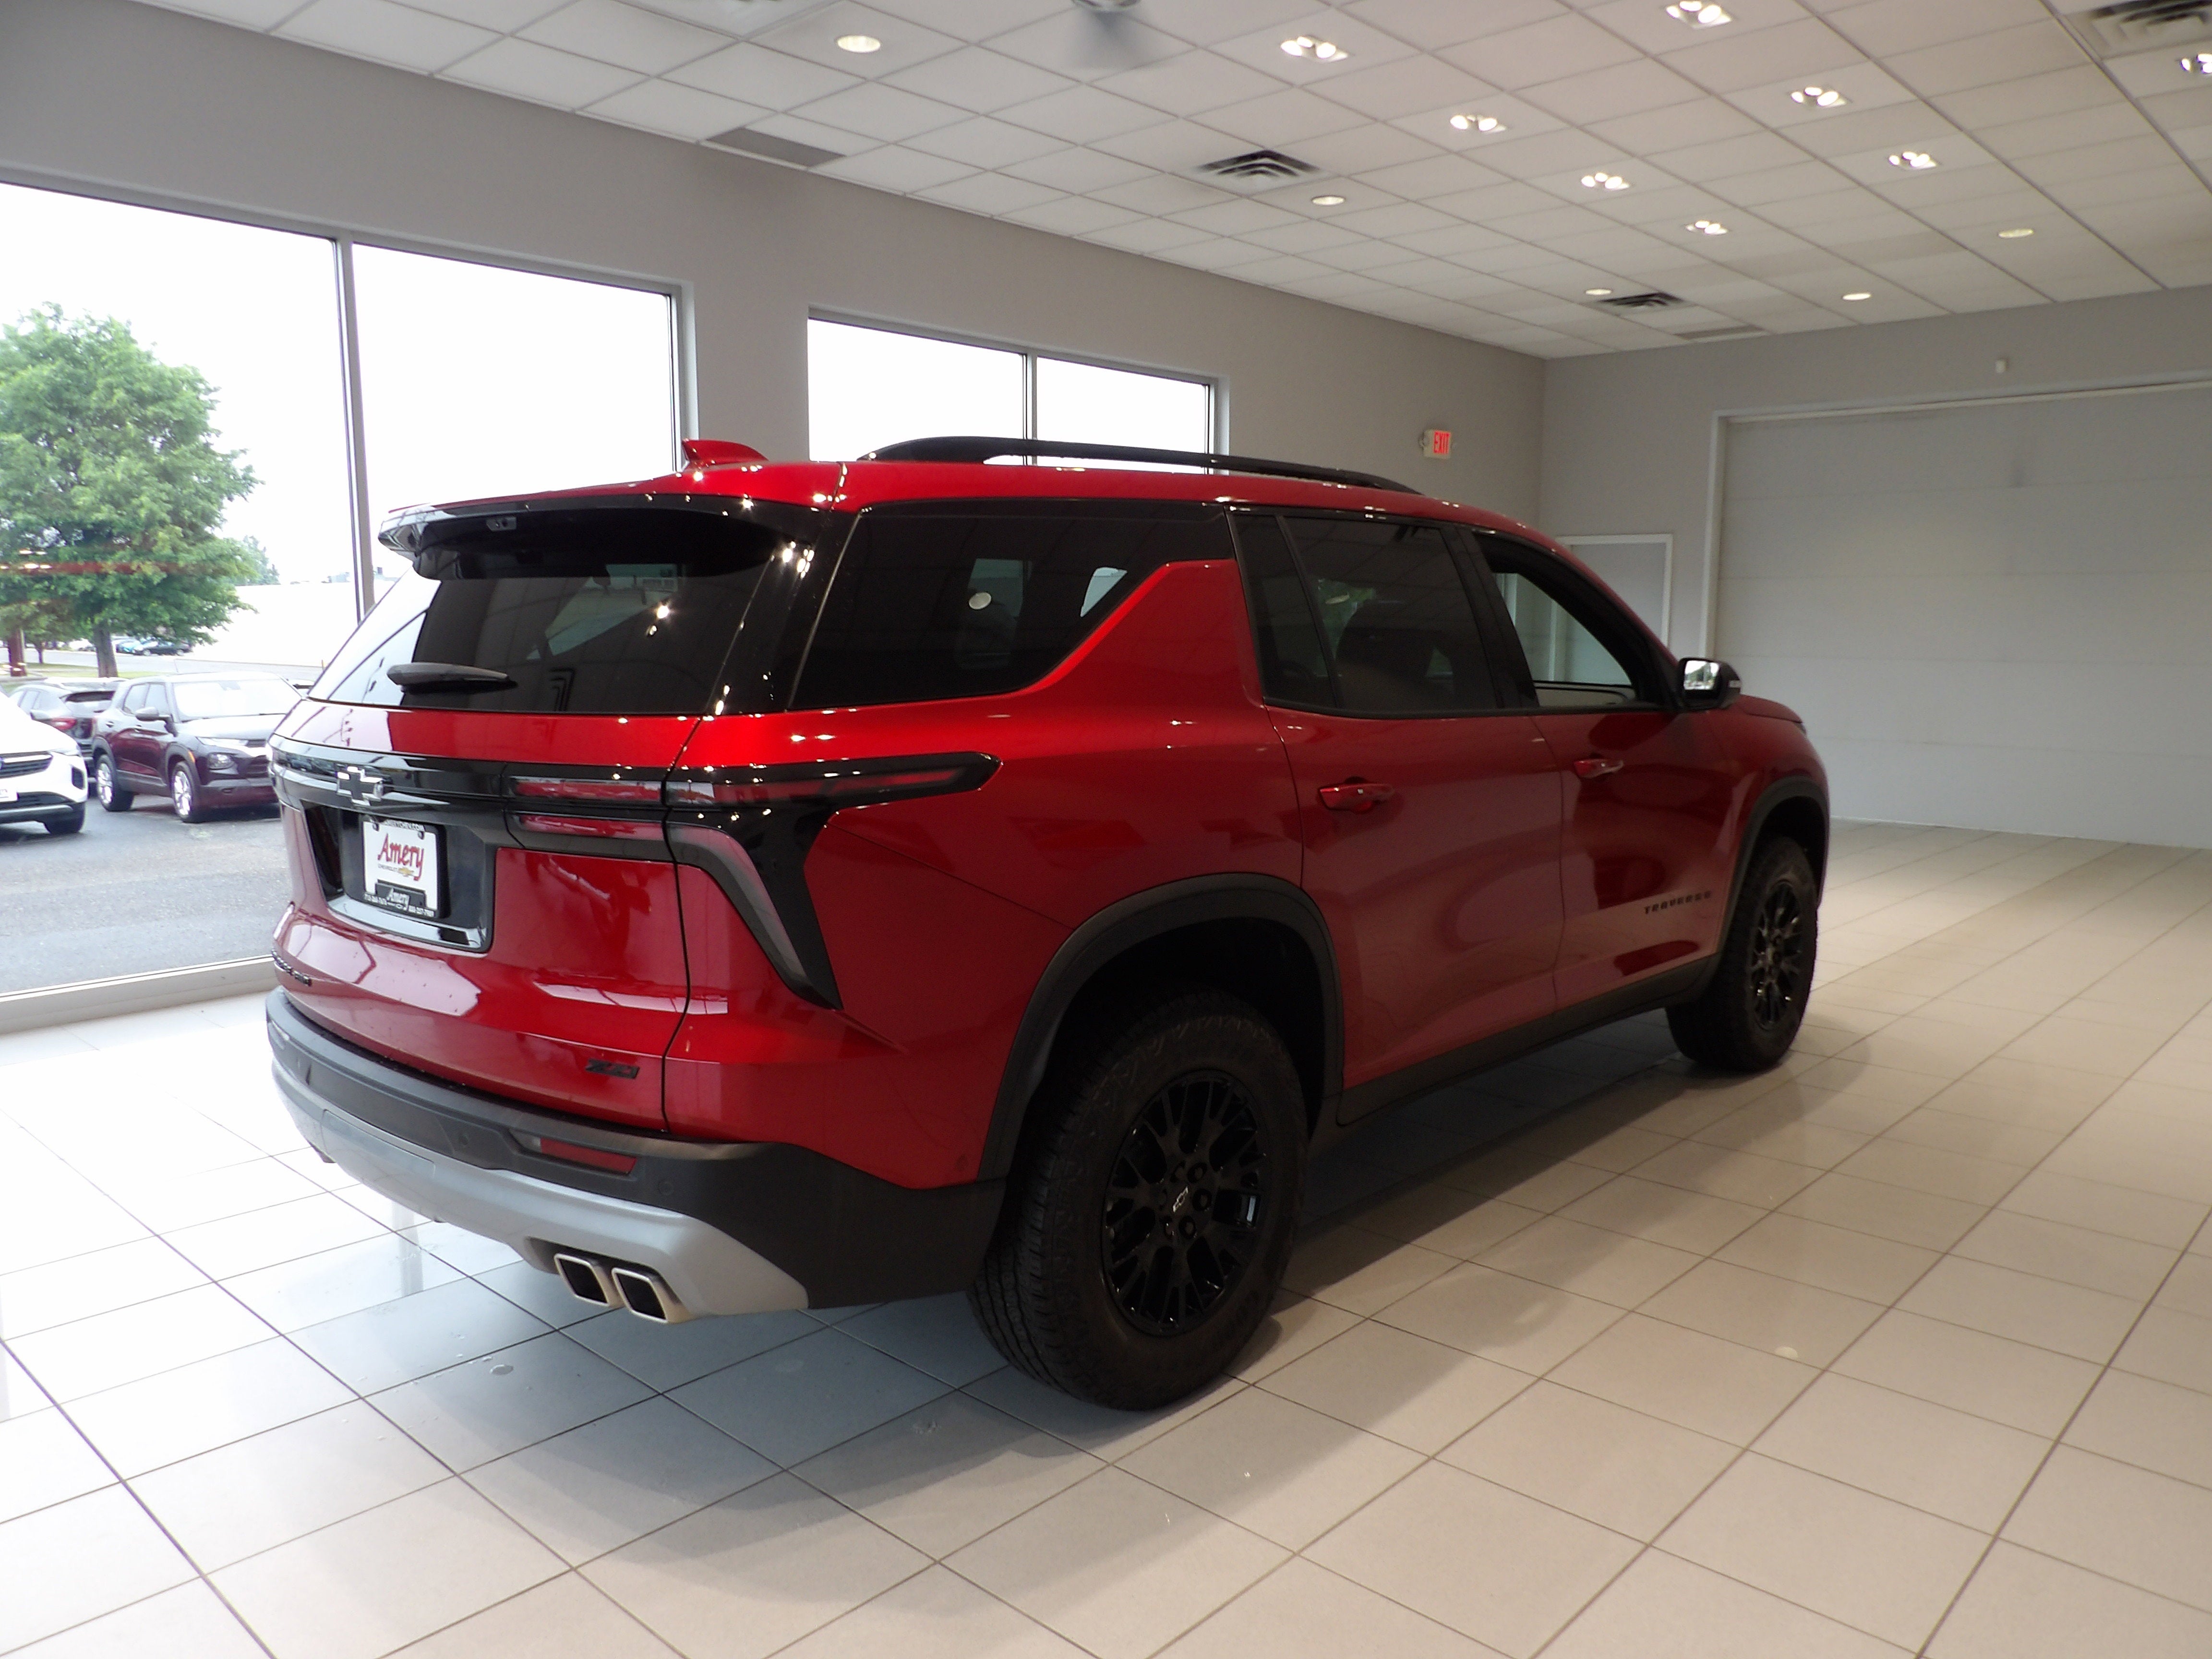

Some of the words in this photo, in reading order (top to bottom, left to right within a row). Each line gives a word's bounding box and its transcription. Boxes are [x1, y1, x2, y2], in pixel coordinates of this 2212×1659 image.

[1433, 431, 1450, 454] EXIT
[377, 833, 424, 881] Amery
[386, 888, 409, 911] Amery
[1645, 890, 1712, 914] TRAVERSE
